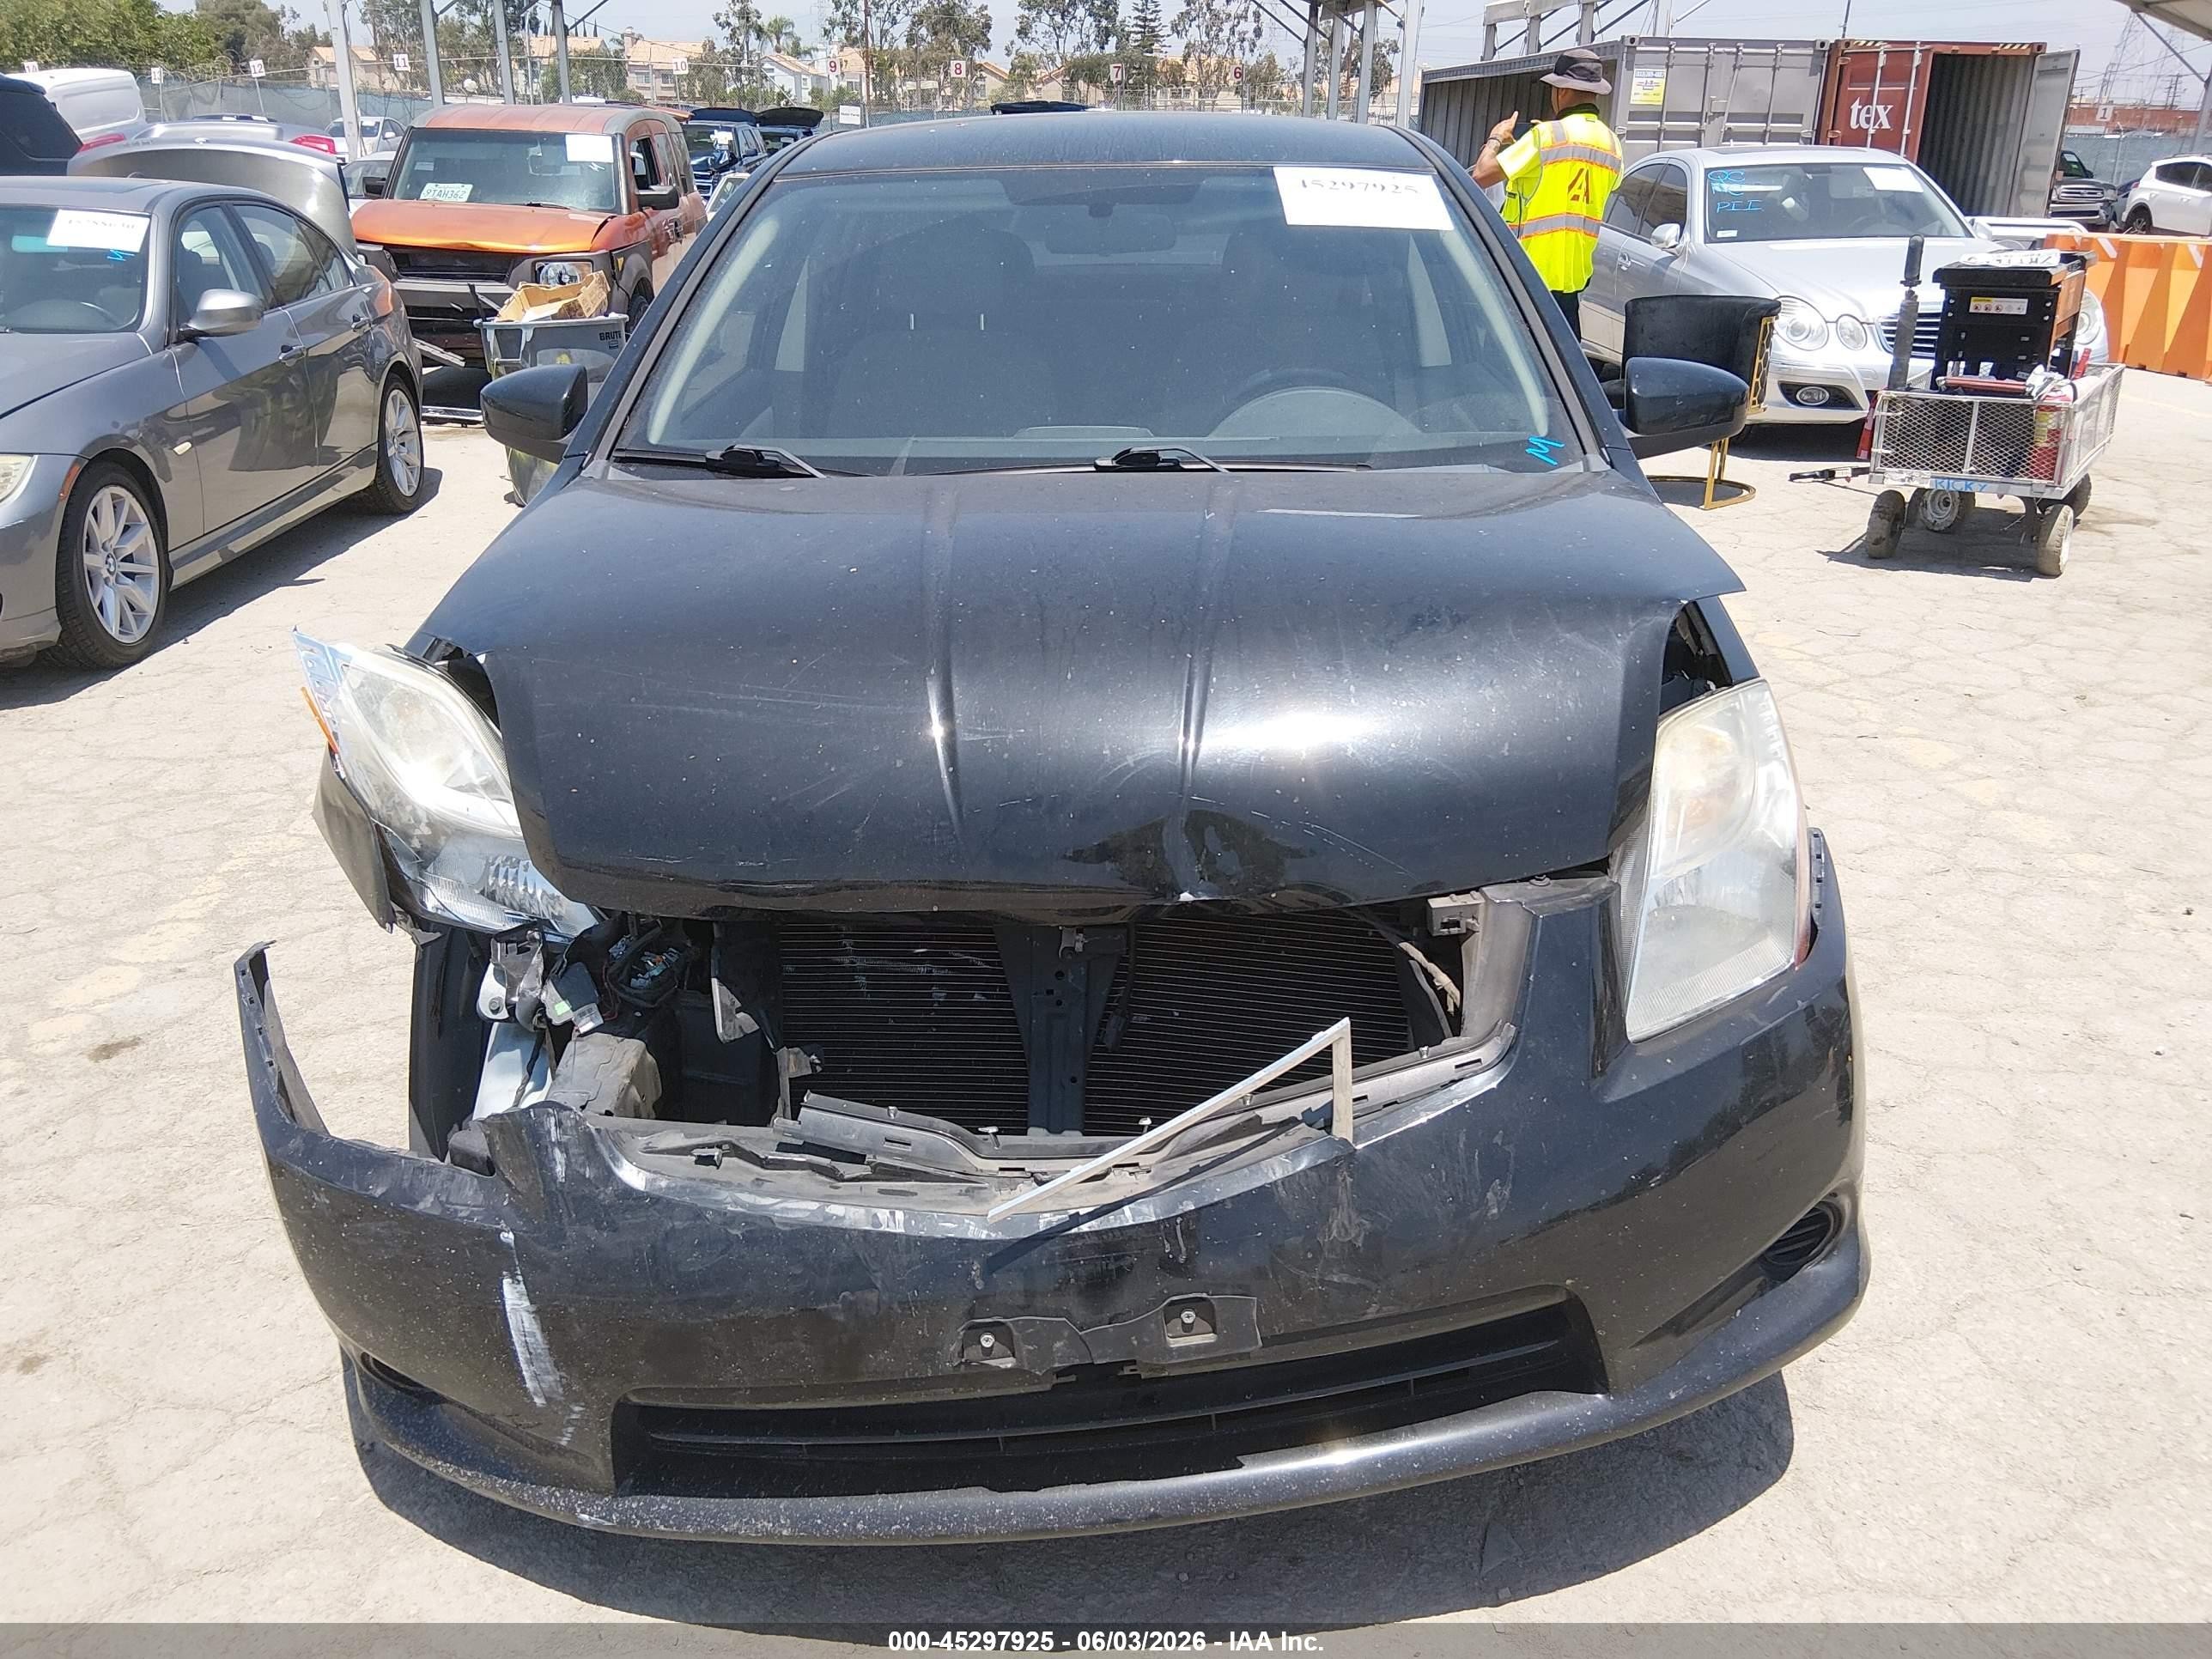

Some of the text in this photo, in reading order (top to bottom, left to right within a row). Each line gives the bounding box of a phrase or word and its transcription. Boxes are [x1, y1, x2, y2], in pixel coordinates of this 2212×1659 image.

[252, 63, 264, 74] 12
[673, 60, 687, 72] 10
[829, 60, 837, 73] 9
[954, 63, 962, 75] 8
[1112, 65, 1121, 79] 7
[1233, 66, 1243, 79] 6
[1850, 96, 1894, 130] tex
[2100, 107, 2108, 119] 1
